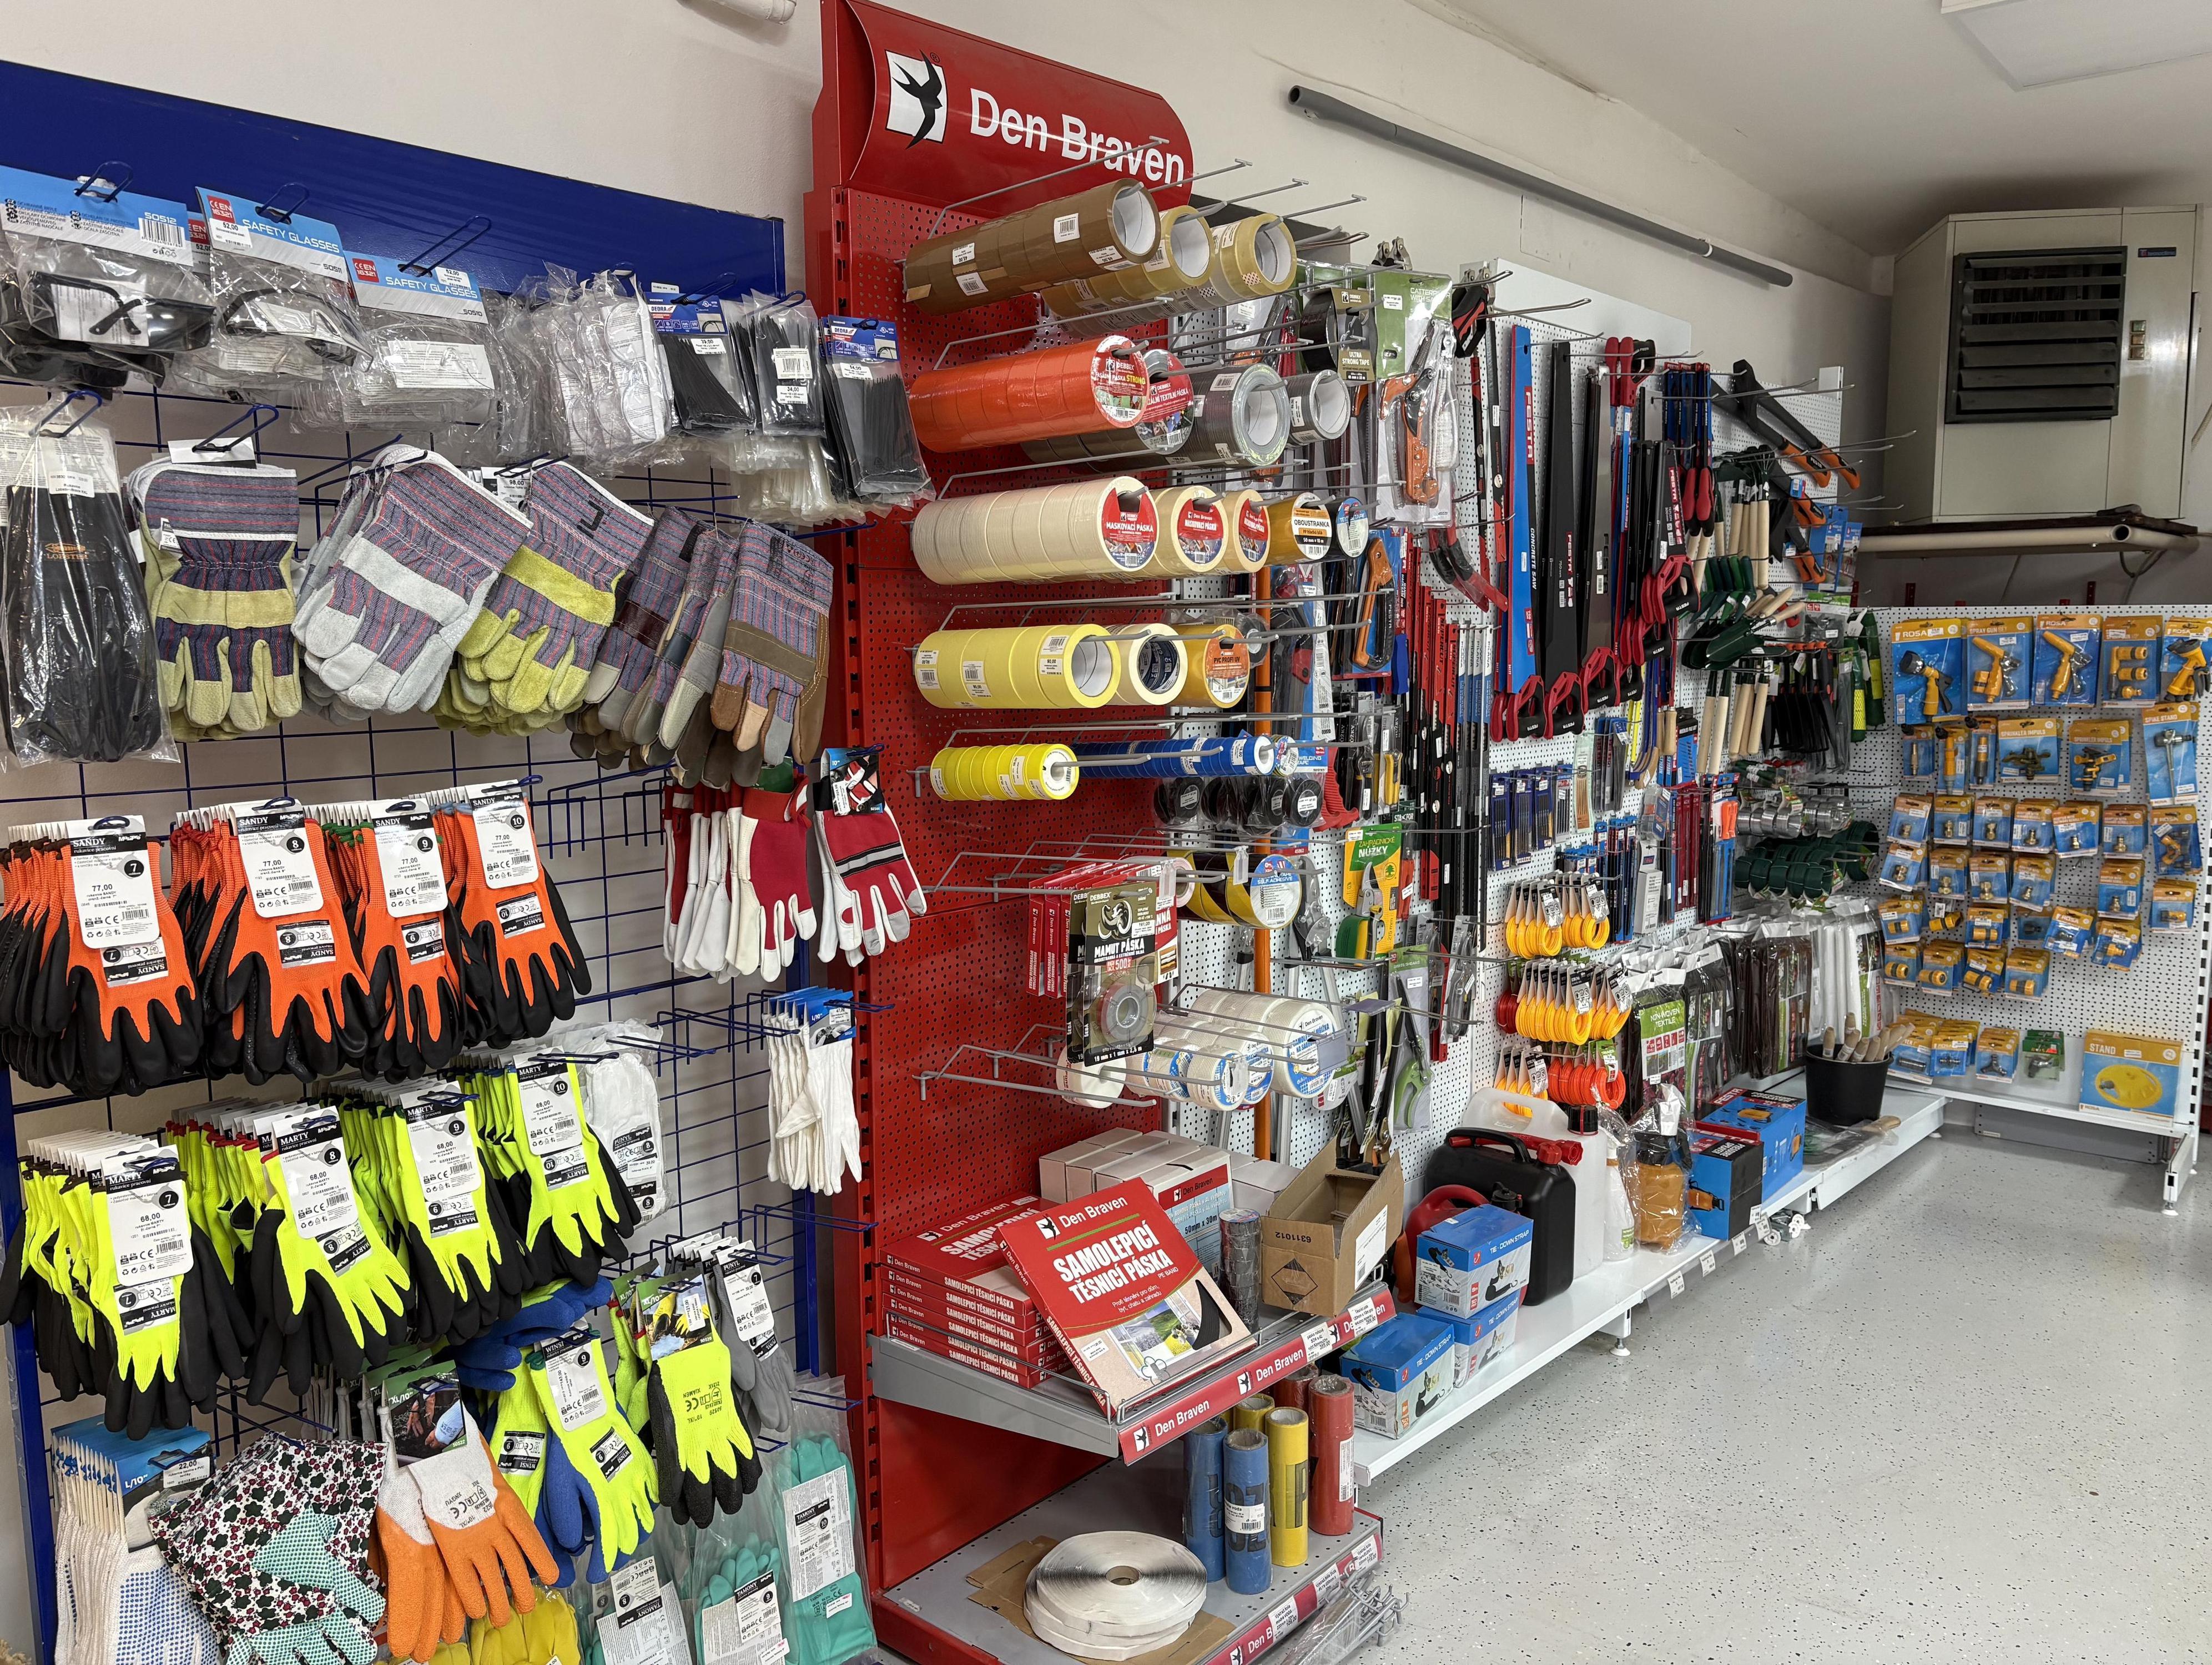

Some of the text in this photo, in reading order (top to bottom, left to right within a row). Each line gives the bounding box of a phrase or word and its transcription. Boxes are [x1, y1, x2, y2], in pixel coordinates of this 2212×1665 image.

[970, 88, 1185, 188] Den Braven
[212, 208, 233, 219] 16321
[242, 219, 286, 239] SAFETY
[289, 231, 339, 253] GLASSES
[385, 277, 477, 299] SAFETY GLASSES
[1116, 361, 1135, 371] DEBBEX
[1126, 375, 1146, 385] STRONG
[1525, 391, 1534, 459] FESTA
[1106, 521, 1153, 532] MASKOVACÍ PÁSKA
[1294, 519, 1329, 528] OBOUSTRANKA
[472, 798, 496, 807] SANDY
[239, 816, 268, 826] SANDY
[376, 817, 401, 828] SANDY
[512, 817, 522, 826] 10
[73, 838, 105, 847] SANDY
[293, 840, 299, 849] 8
[421, 839, 429, 849] 9
[1359, 835, 1395, 847] ZAHRADNICKÉ
[1359, 845, 1388, 858] NÚŽKY
[401, 856, 418, 865] 77,00
[130, 864, 137, 872] 7
[92, 884, 113, 892] 77,00
[1090, 892, 1111, 901] DEBBEX
[311, 949, 334, 957] SANDY
[1094, 937, 1145, 958] MAMUT PÁSKA
[138, 963, 165, 974] SANDY
[1312, 1014, 1323, 1025] Braven
[1655, 1017, 1675, 1028] TEXTILE
[2089, 1043, 2116, 1056] STAND
[519, 1065, 542, 1076] MARTY
[555, 1083, 566, 1092] 10
[407, 1104, 434, 1116] MARTY
[536, 1100, 551, 1109] 68,00
[452, 1122, 460, 1132] 9
[280, 1132, 309, 1146] MARTY
[281, 1142, 299, 1151] rukavice
[437, 1141, 454, 1150] 68,00
[645, 1142, 652, 1151] 8
[330, 1151, 336, 1160] 8
[109, 1172, 142, 1185] MARTY
[310, 1171, 326, 1180] 68,00
[1183, 1178, 1213, 1195] Den Braven
[165, 1194, 172, 1204] 7
[644, 1198, 652, 1208] 8
[140, 1212, 160, 1223] 68,00
[940, 1202, 1010, 1232] Den Braven
[1058, 1196, 1128, 1228] Den Braven
[1185, 1223, 1201, 1234] 50mm
[1206, 1215, 1217, 1225] 30m
[1275, 1230, 1312, 1244] 6311012
[1500, 1237, 1514, 1249] DOWN
[1514, 1229, 1529, 1243] STRAP
[1053, 1219, 1160, 1283] SAMOLEPICÍ
[723, 1260, 740, 1271] PUNYL
[1006, 1250, 1029, 1286] Den Braven
[1068, 1249, 1174, 1304] TĚSNICÍ PÁSKA
[944, 1276, 1014, 1310] SAMOLEPICÍ TĚSNICÍ PÁSKA
[150, 1306, 175, 1319] MARTY
[946, 1292, 1015, 1325] SAMOLEPICÍ TĚSNICÍ PÁSKA
[946, 1307, 1015, 1341] SAMOLEPICÍ TĚSNICÍ PÁSKA
[948, 1321, 1018, 1355] SAMOLEPICÍ TĚSNICÍ PÁSKA
[545, 1341, 565, 1354] WINSI
[1425, 1347, 1438, 1360] DOWN
[1438, 1334, 1451, 1349] STRAP
[949, 1350, 1019, 1383] SAMOLEPICÍ TĚSNICÍ PÁSKA
[1255, 1347, 1304, 1383] Den Braven
[1154, 1397, 1210, 1437] Den Braven
[179, 1460, 197, 1470] 22,00
[1248, 1636, 1264, 1653] Den
